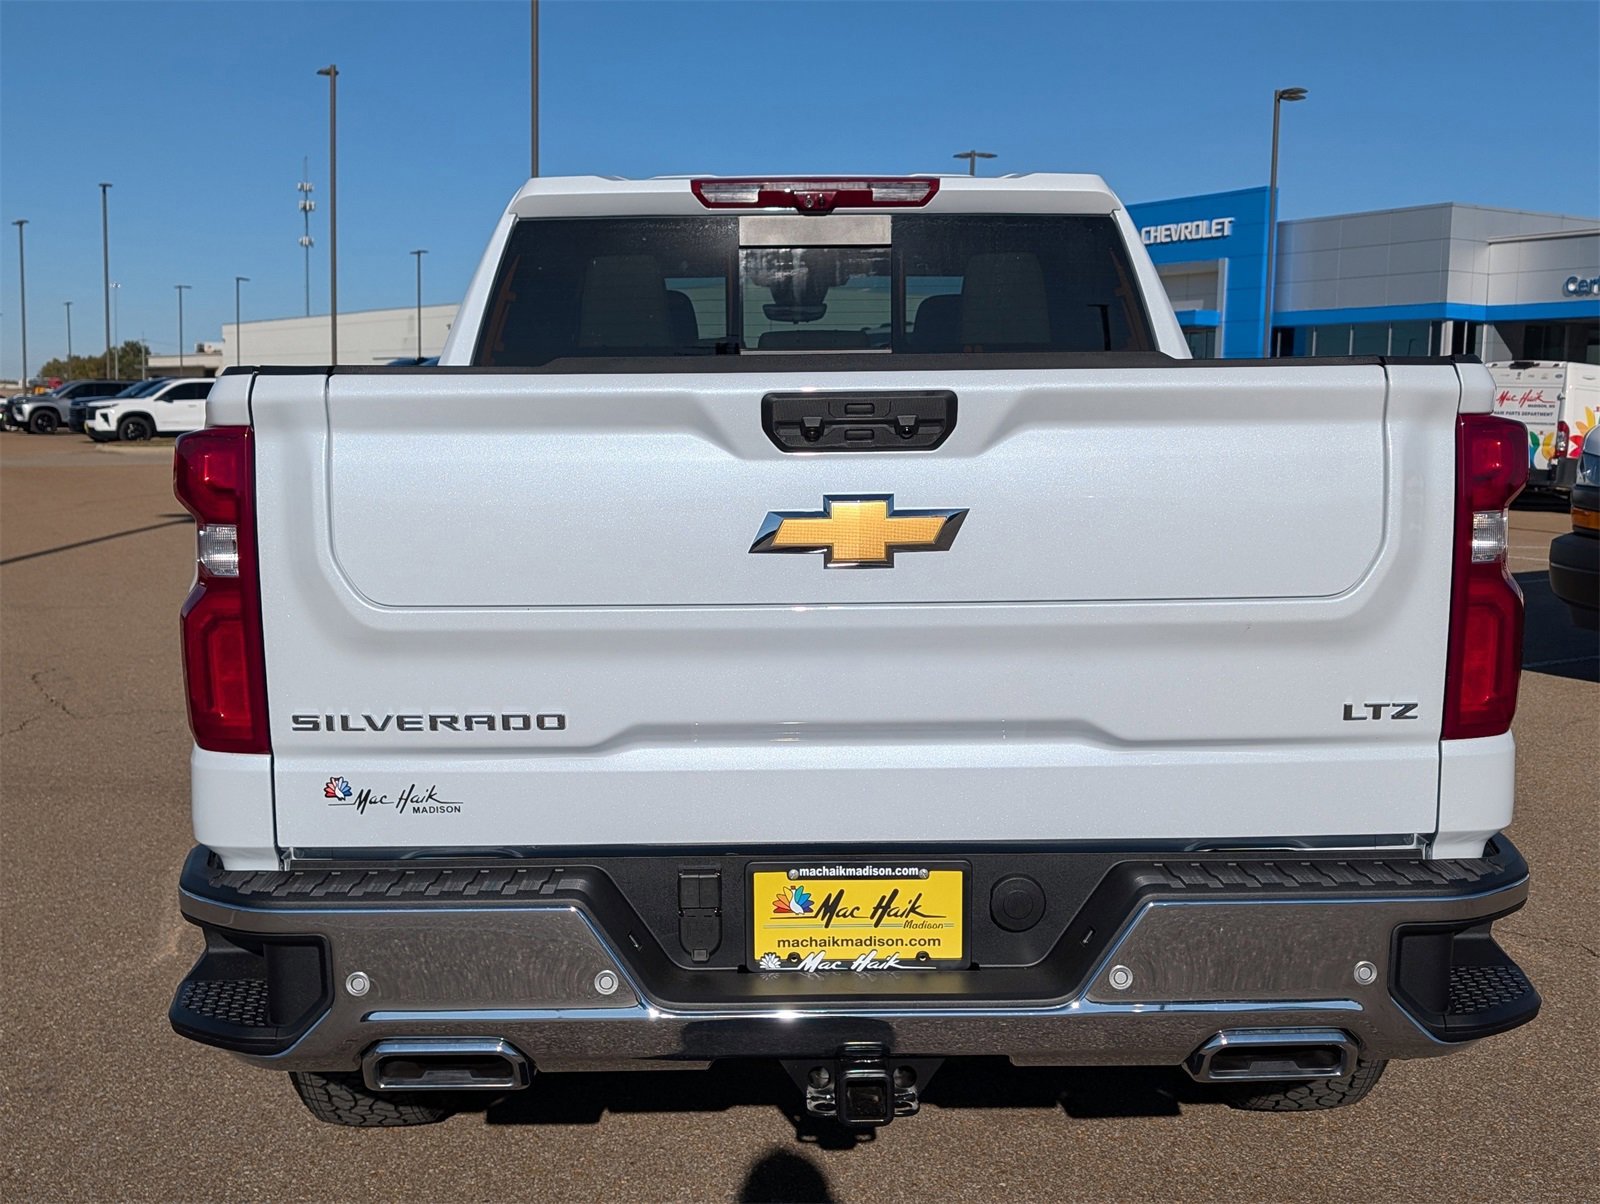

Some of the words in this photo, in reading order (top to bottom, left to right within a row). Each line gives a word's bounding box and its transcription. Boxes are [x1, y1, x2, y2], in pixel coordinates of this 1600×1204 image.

[1141, 217, 1235, 245] CHEVROLET
[1343, 703, 1419, 721] LTZ
[291, 713, 566, 732] SILVERADO
[352, 788, 394, 815] Mac
[395, 784, 464, 814] Haik
[412, 805, 461, 814] MADISON
[799, 866, 919, 877] machaikmadison.com
[813, 888, 866, 928] Mac
[868, 888, 947, 928] Haik
[903, 919, 944, 930] Madison
[777, 936, 941, 948] machaikmadison.com
[797, 950, 848, 972] Mac
[850, 950, 936, 972] Haik
